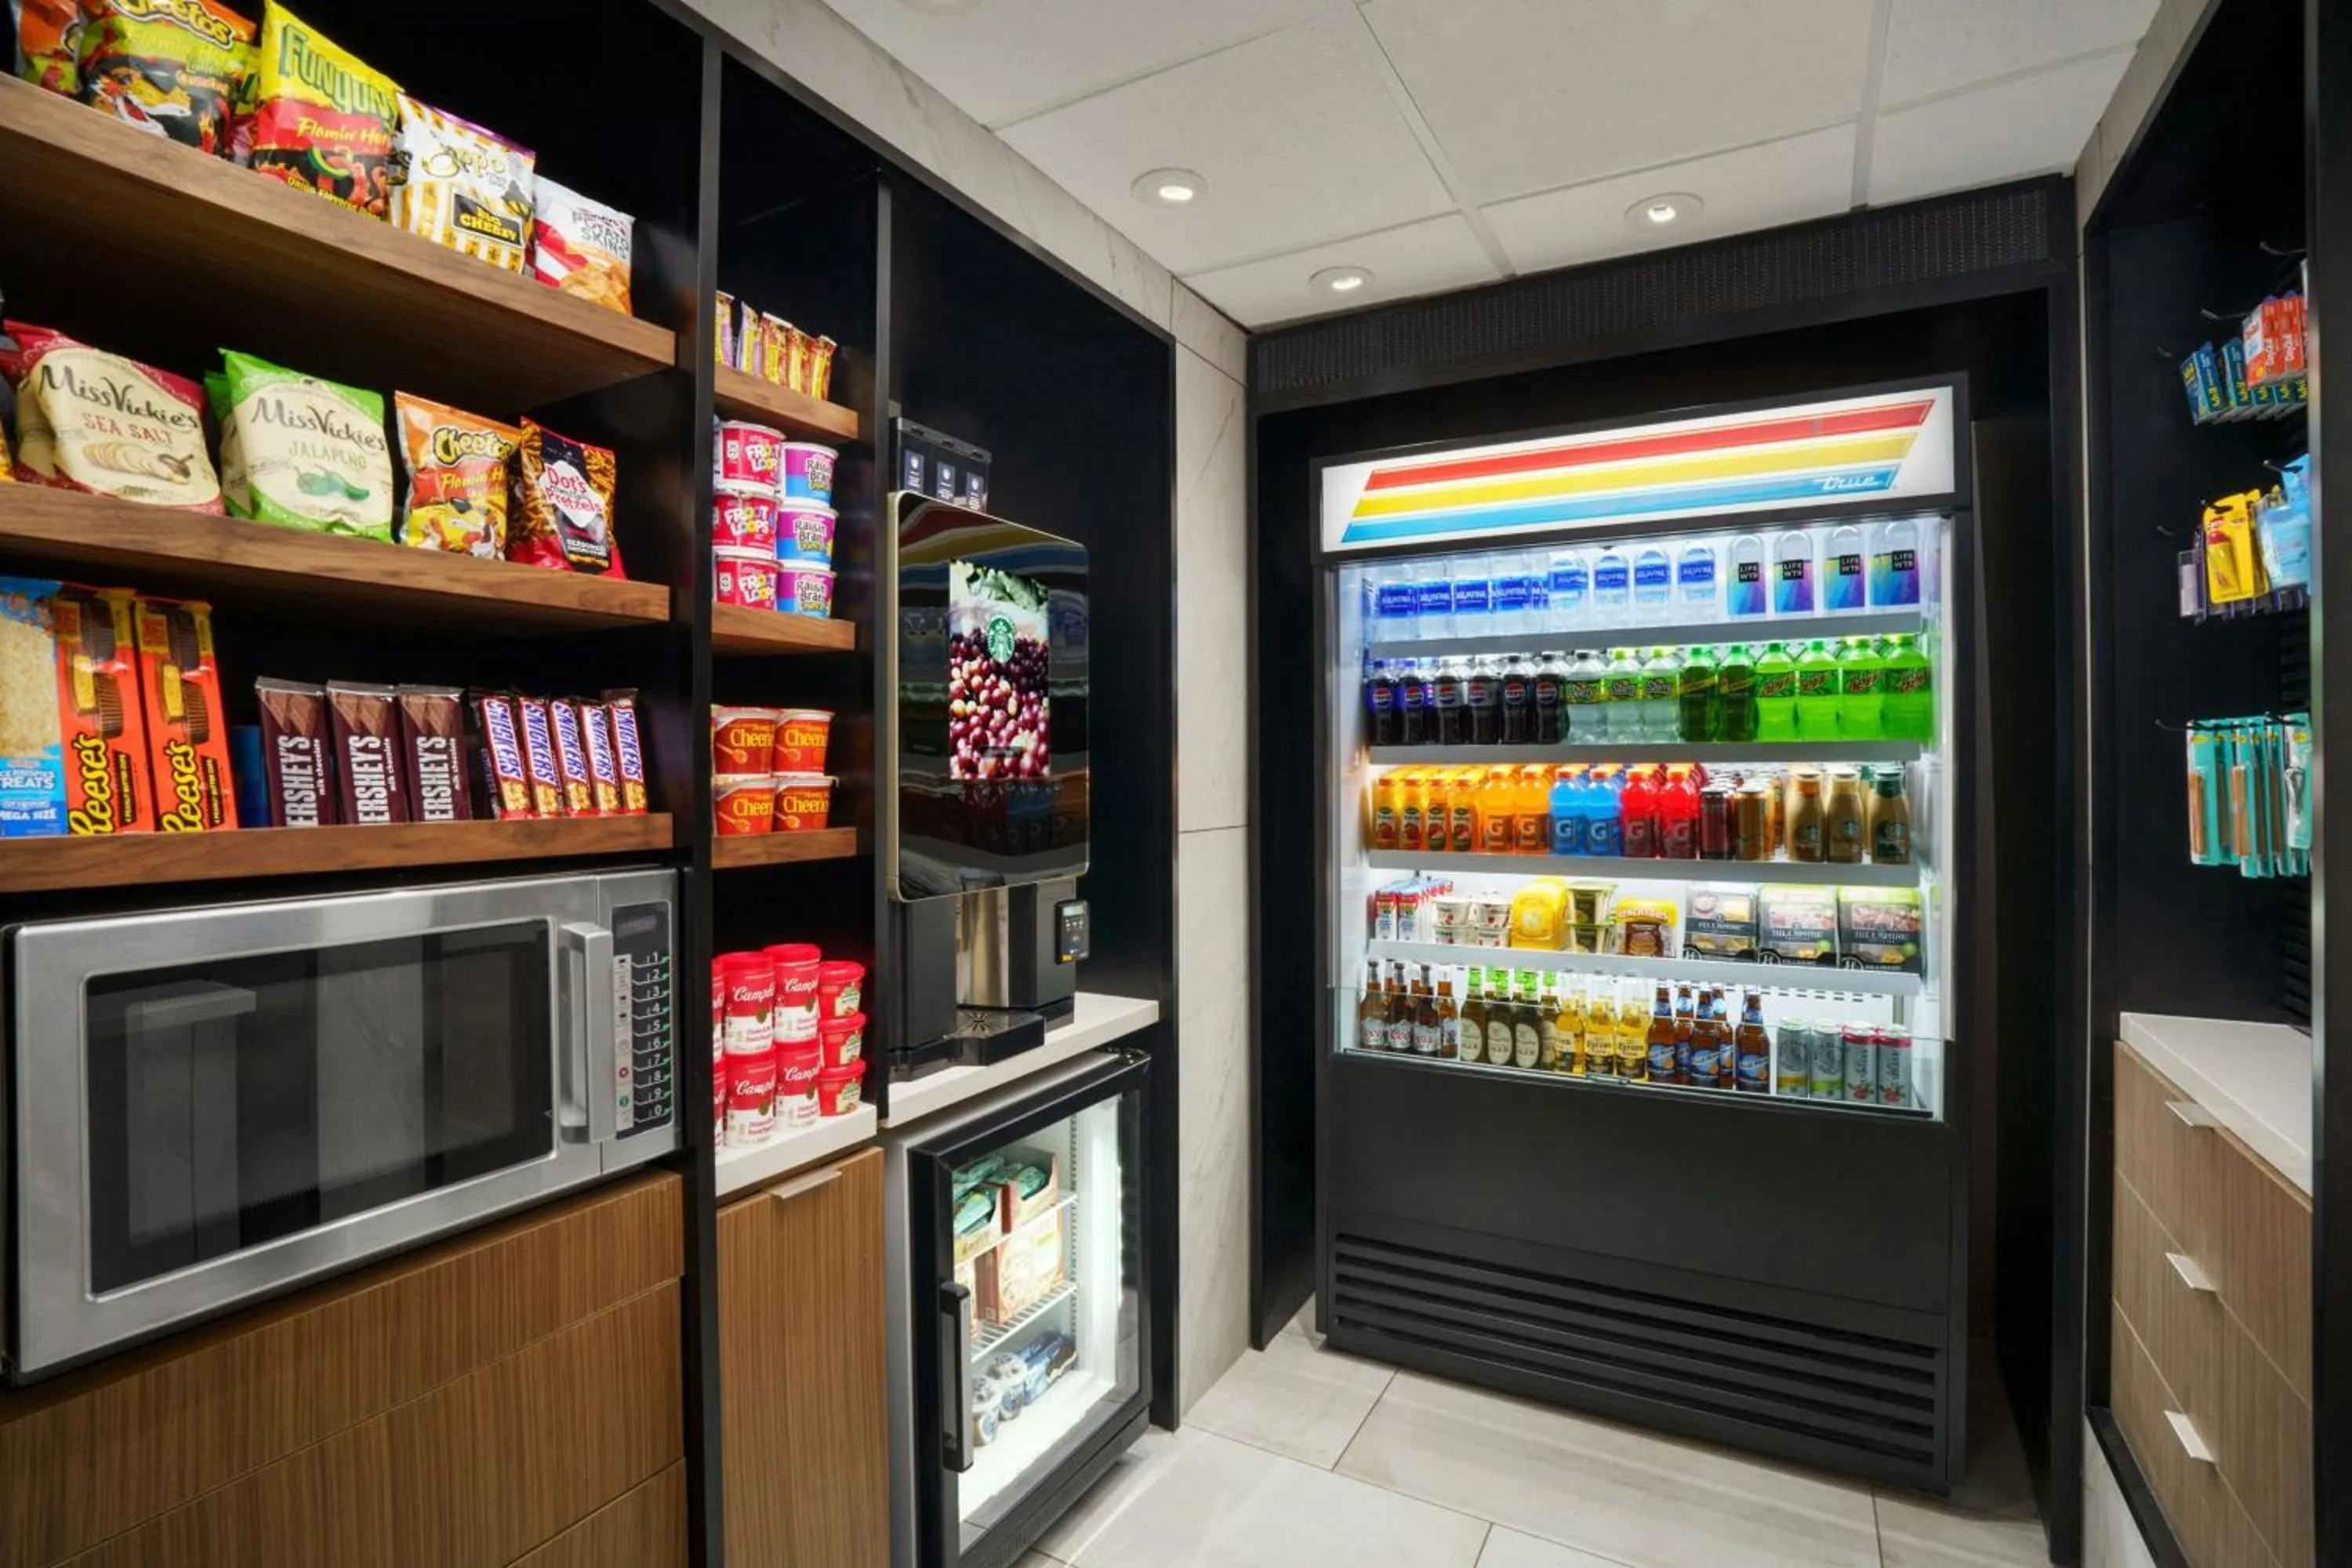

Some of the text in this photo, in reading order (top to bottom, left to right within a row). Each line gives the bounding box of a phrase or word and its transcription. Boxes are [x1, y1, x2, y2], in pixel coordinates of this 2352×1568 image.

[40, 365, 200, 432] Miss Vickie's
[82, 412, 174, 446] SEA SALT
[251, 397, 387, 455] Miss Vickie's
[546, 464, 587, 494] Dot's
[1893, 552, 1913, 561] LIFE
[1784, 562, 1803, 571] LIFE
[486, 701, 521, 779] SNICKERS
[524, 702, 555, 782] SNICKERS
[554, 701, 586, 780] SNICKERS
[590, 710, 615, 784] SNICKERS
[615, 710, 641, 781] SNICKERS
[0, 775, 55, 789] REATS
[278, 735, 319, 827] ERSHEY'S
[348, 735, 390, 824] ERSHEY'S
[416, 736, 455, 822] ERSHEY'S
[1490, 820, 1504, 836] G
[1521, 820, 1535, 836] G
[1555, 820, 1572, 838] G
[1591, 822, 1607, 840] G
[1628, 822, 1644, 840] G
[1673, 822, 1690, 840] G
[652, 952, 658, 964] 1
[652, 969, 659, 980] 2
[652, 985, 659, 997] 3
[652, 1003, 660, 1014] 4
[653, 1037, 661, 1049] 6
[654, 1054, 661, 1065] 7
[655, 1105, 662, 1116] 0
